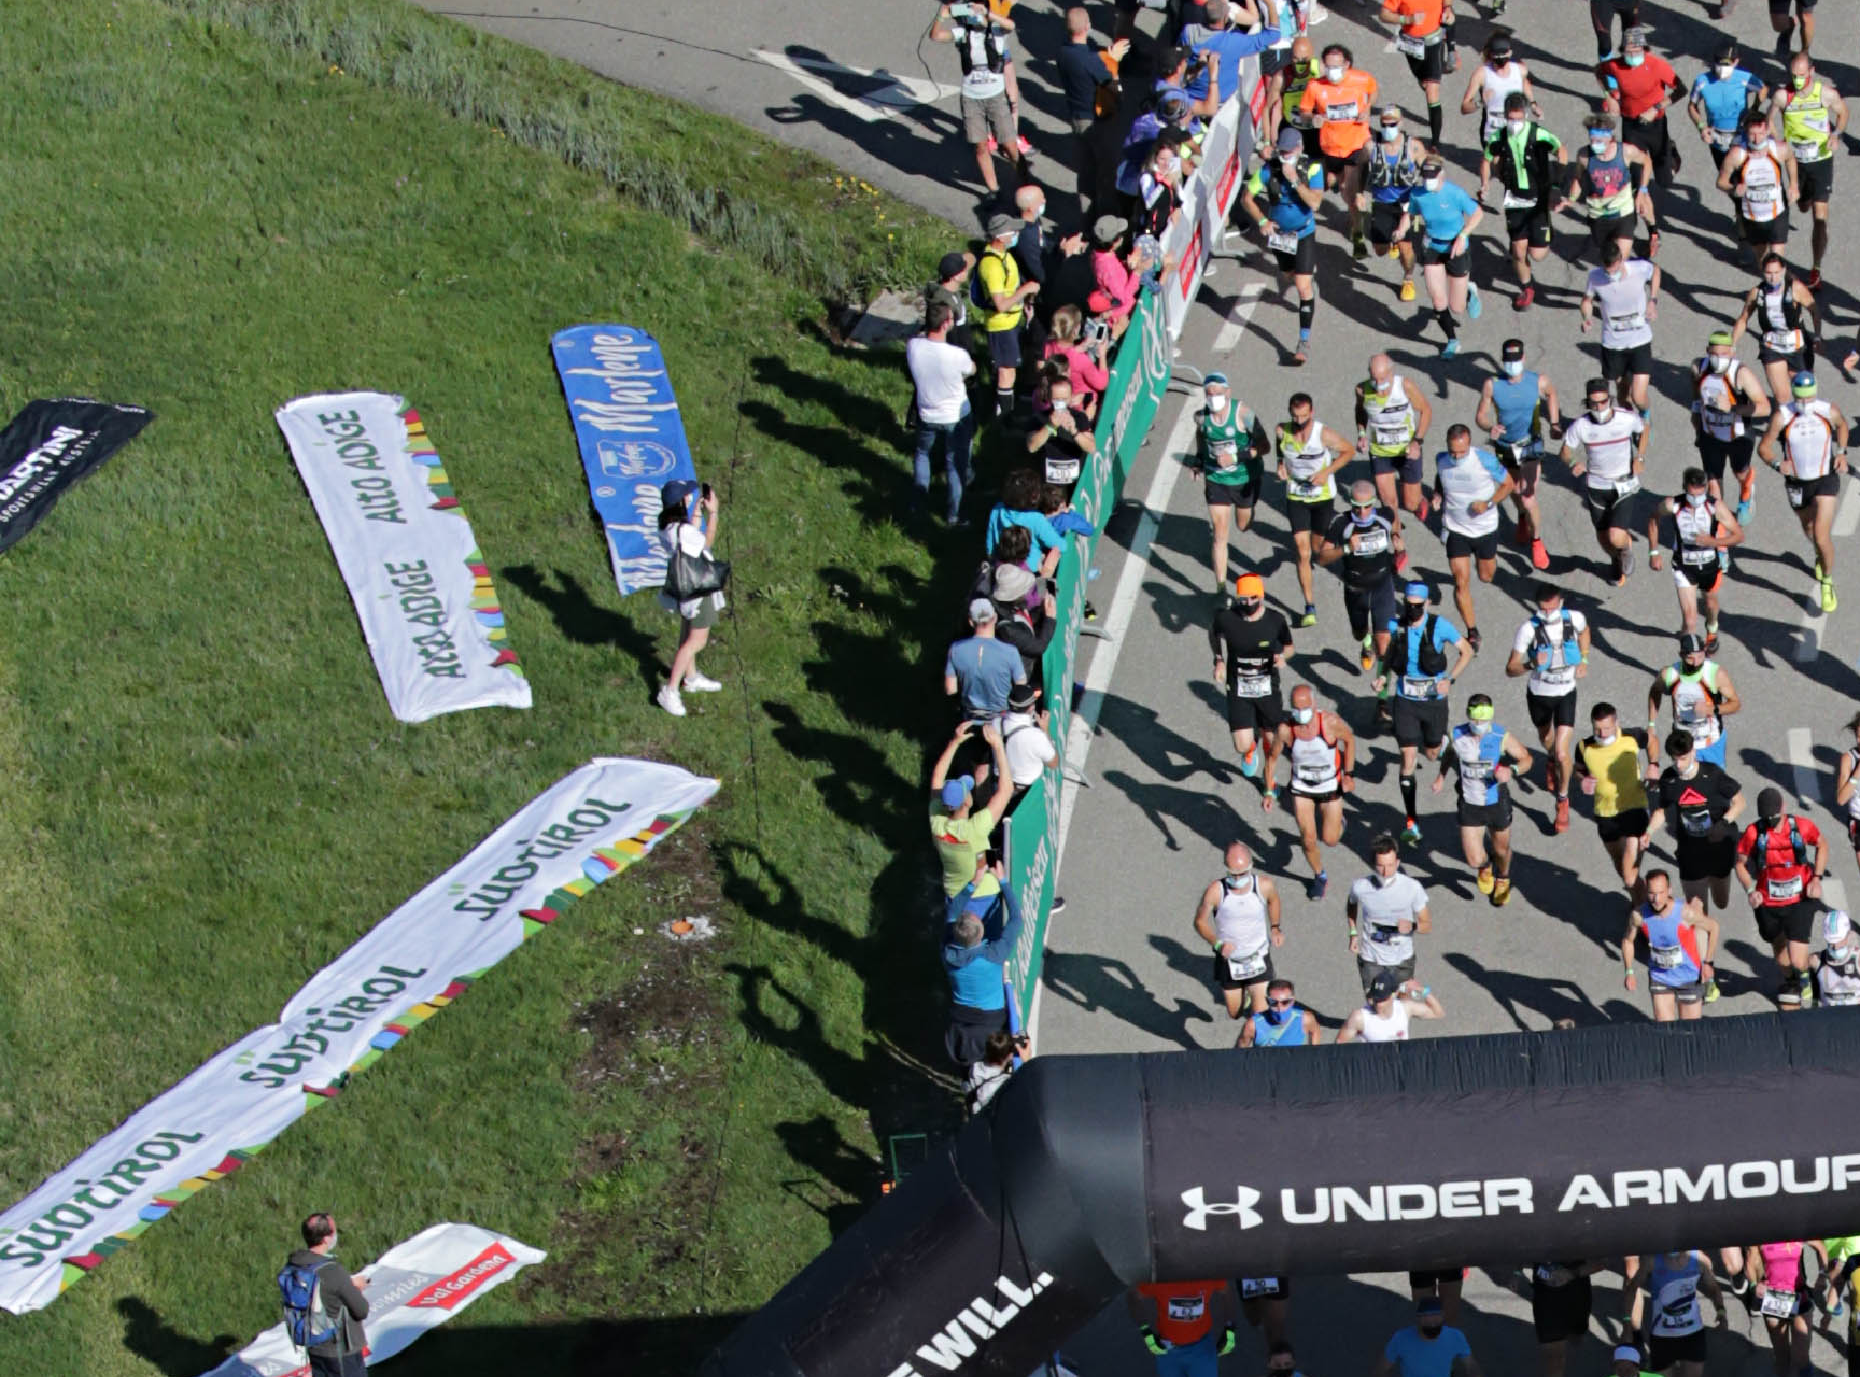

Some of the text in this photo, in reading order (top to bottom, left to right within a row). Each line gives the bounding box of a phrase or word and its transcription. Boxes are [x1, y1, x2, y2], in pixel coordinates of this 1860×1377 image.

[572, 333, 678, 435] Marlene
[1281, 1177, 1533, 1225] UNDER
[418, 1252, 508, 1308] Val Gardena
[915, 1271, 1055, 1372] WILL.
